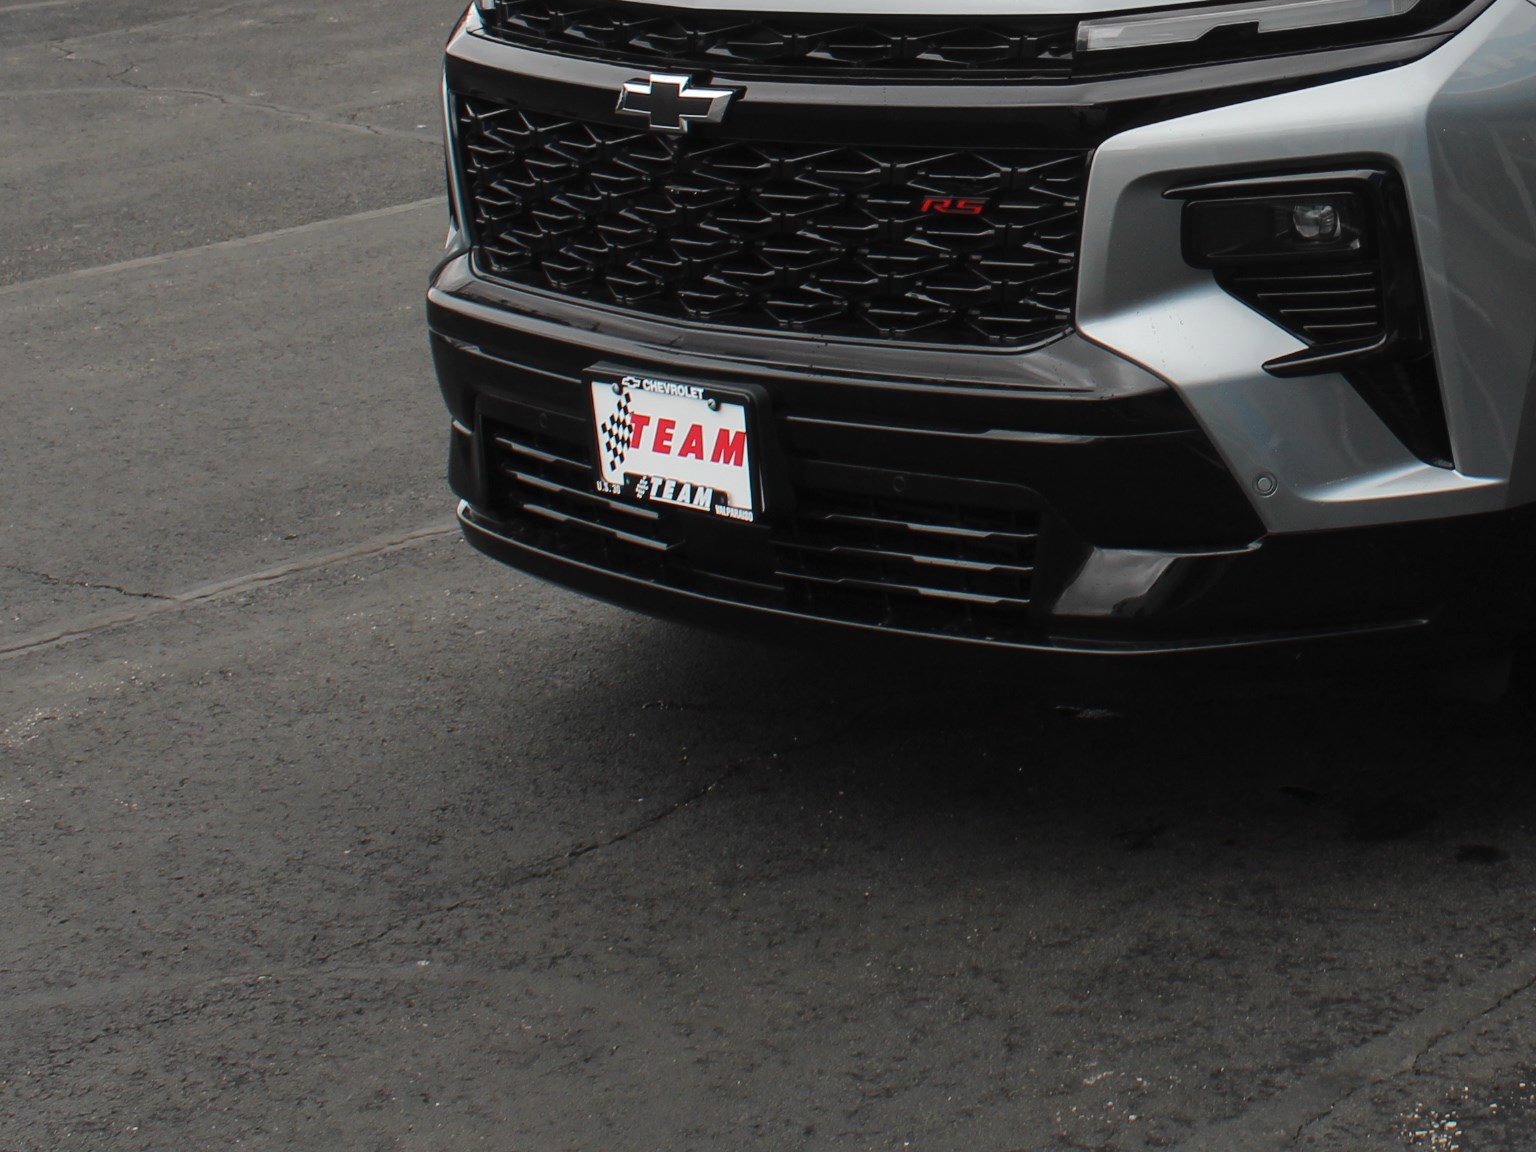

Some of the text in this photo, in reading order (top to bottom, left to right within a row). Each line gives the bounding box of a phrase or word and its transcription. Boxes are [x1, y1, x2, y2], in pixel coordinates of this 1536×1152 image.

[921, 199, 986, 214] RS
[642, 379, 704, 399] CHEVROLET
[630, 413, 747, 467] TEAM
[650, 476, 713, 508] TEAM
